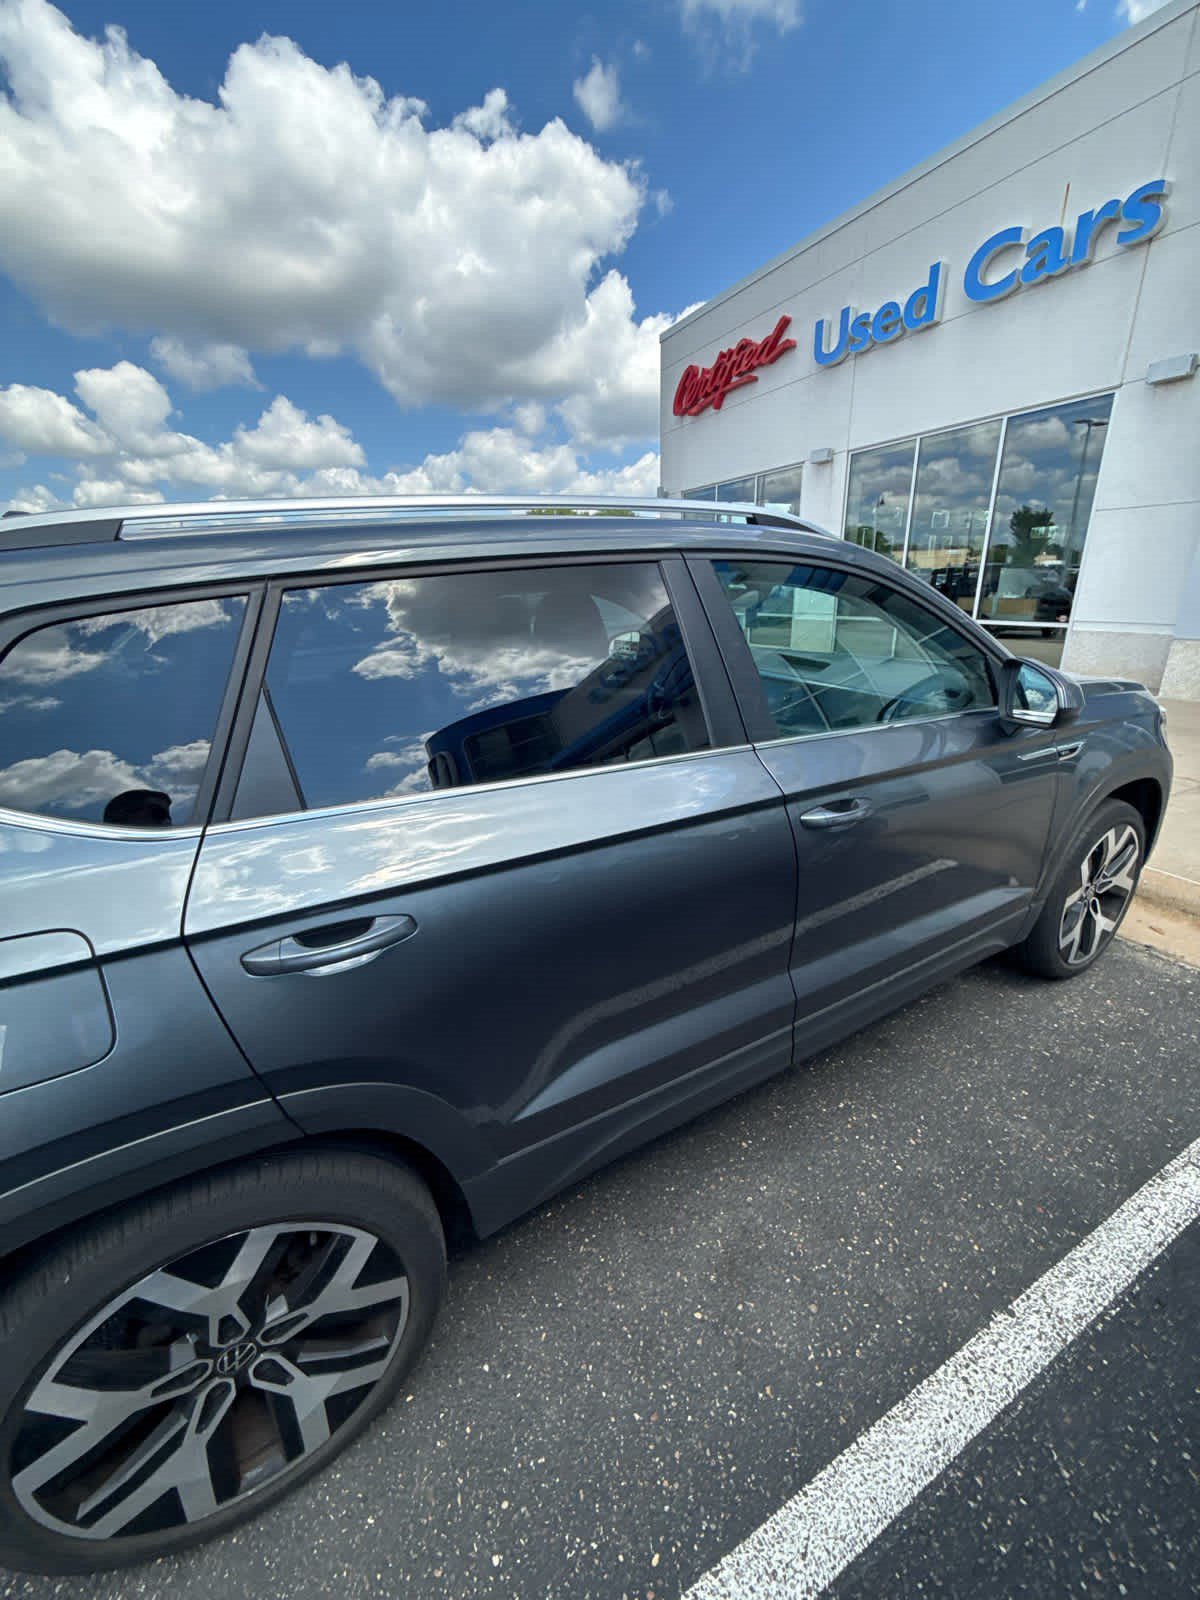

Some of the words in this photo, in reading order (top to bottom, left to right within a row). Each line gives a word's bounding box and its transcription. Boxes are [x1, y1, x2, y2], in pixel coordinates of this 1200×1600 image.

[673, 315, 797, 416] Certified
[814, 262, 946, 367] Used
[964, 179, 1168, 302] Cars
